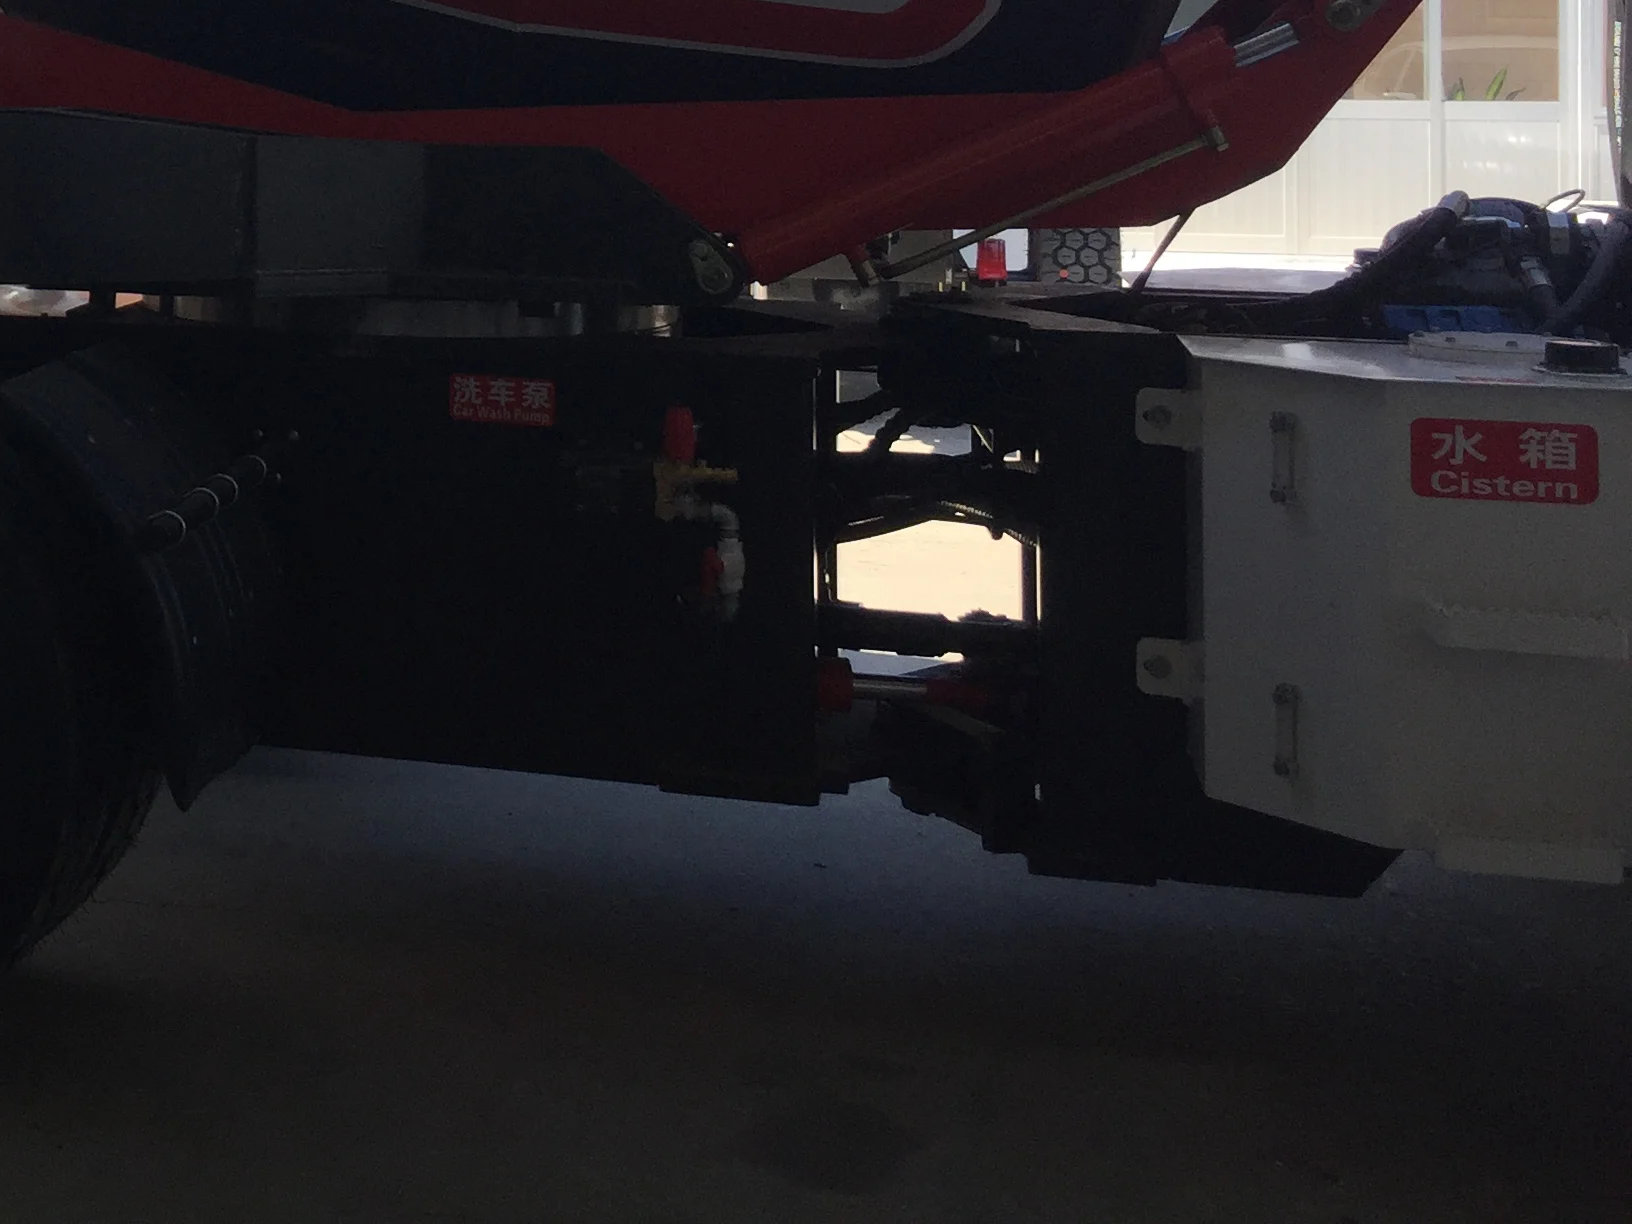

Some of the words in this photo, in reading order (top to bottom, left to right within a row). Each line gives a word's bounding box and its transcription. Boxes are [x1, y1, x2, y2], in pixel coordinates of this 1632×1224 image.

[453, 375, 553, 409] 洗车泵
[452, 403, 475, 417] Car
[476, 405, 511, 421] Wash
[514, 408, 550, 426] Pump
[1430, 424, 1578, 471] 水箱
[1430, 469, 1578, 500] Cistern
